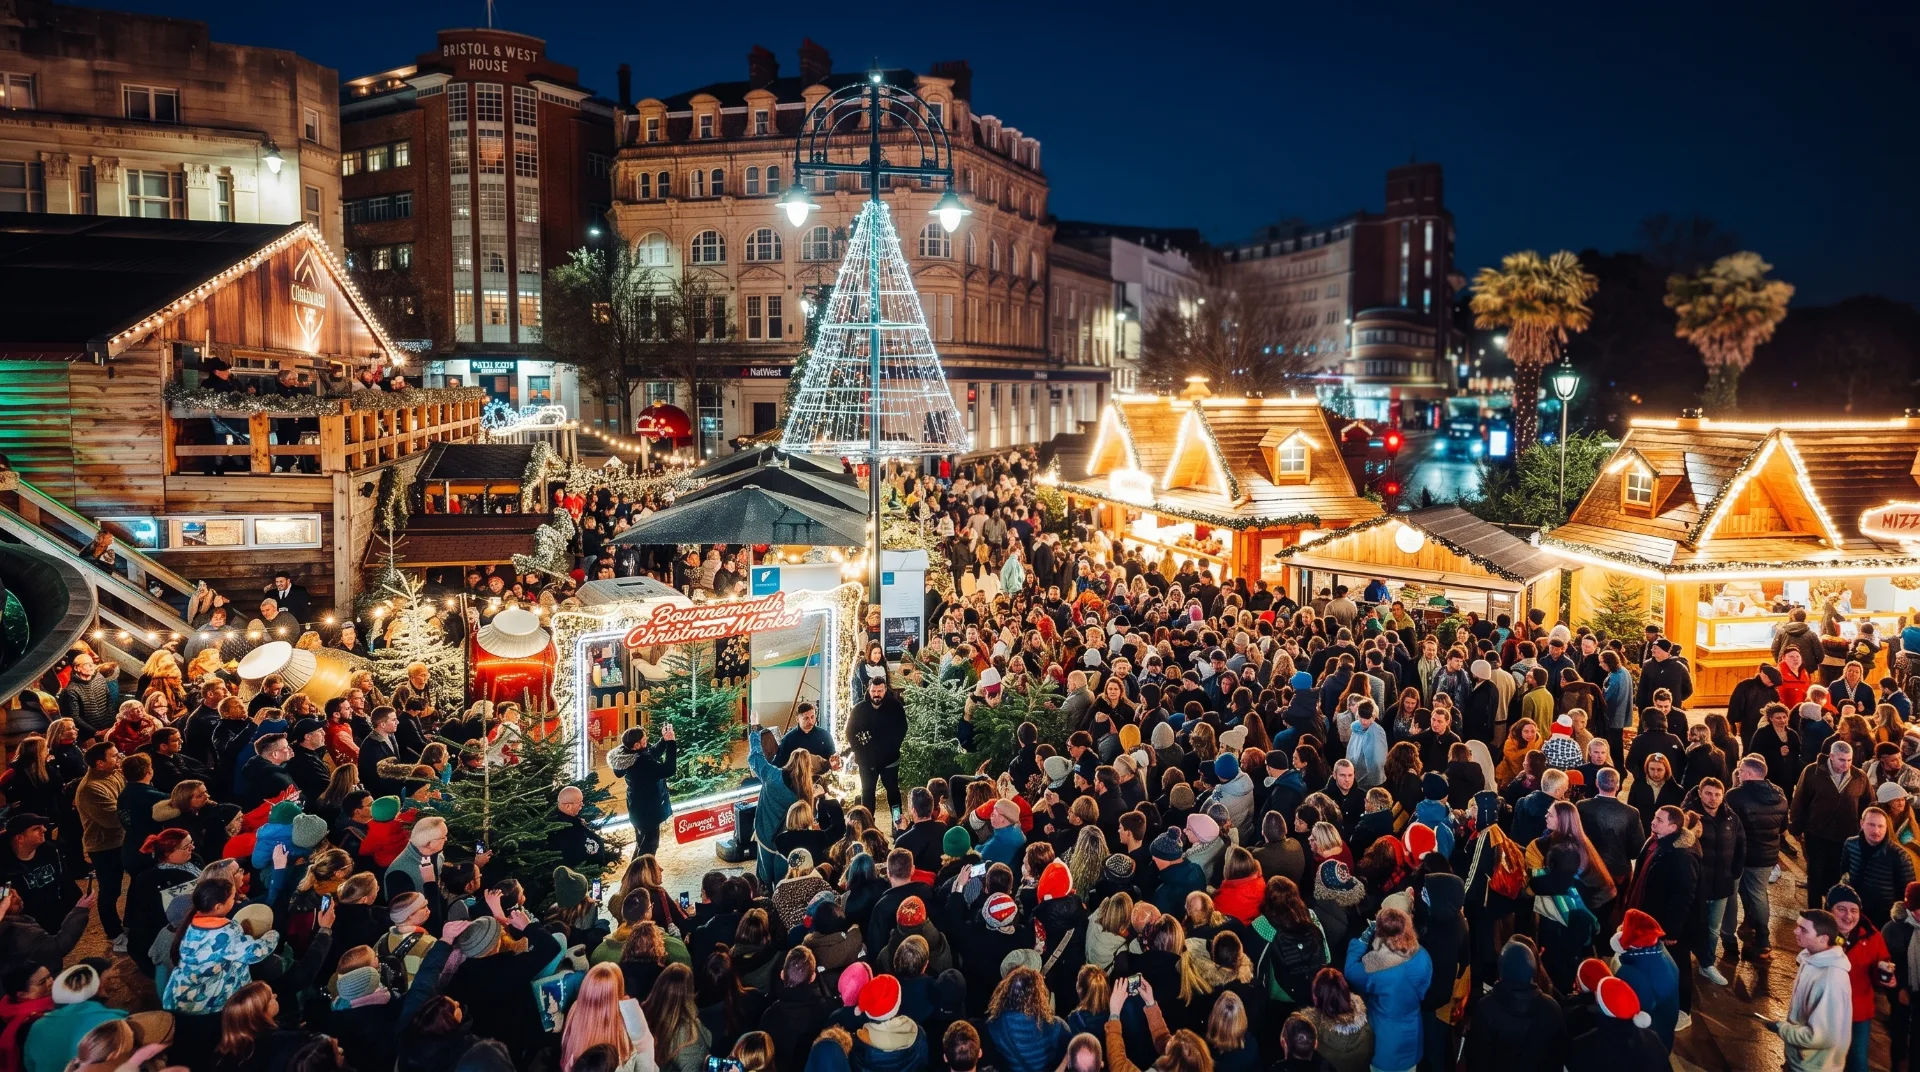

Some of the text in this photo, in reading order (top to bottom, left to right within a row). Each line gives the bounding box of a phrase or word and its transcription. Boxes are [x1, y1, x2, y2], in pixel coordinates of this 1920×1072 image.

[444, 43, 537, 63] BRISTOL & WEST
[470, 58, 508, 73] HOUSE
[750, 367, 781, 377] NatWest
[654, 593, 784, 625] Bournemouth
[627, 611, 800, 647] Christmas Market
